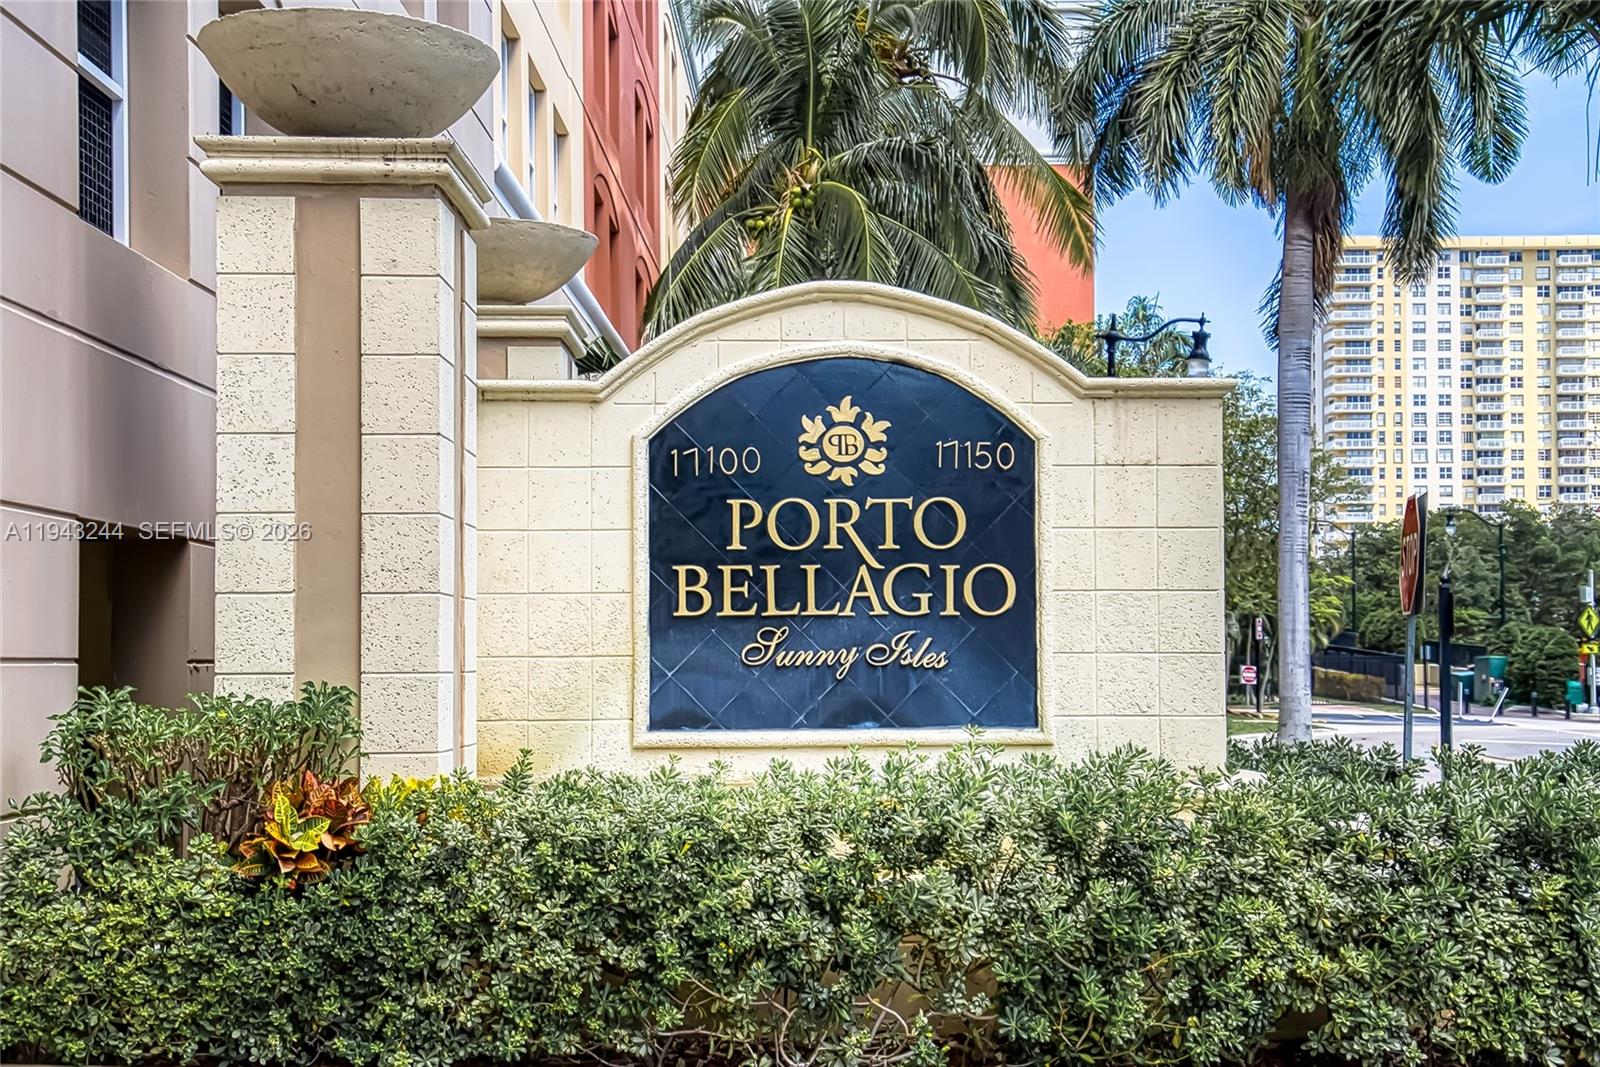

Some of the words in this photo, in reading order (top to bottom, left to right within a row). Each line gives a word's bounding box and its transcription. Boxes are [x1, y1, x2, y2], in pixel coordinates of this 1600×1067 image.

[670, 446, 761, 477] 17100
[935, 440, 1016, 470] 17150
[725, 496, 967, 569] PORTO
[1401, 533, 1418, 577] STOP
[673, 563, 1017, 617] BELLAGIO
[741, 626, 859, 680] Sunny
[865, 630, 949, 670] Isles
